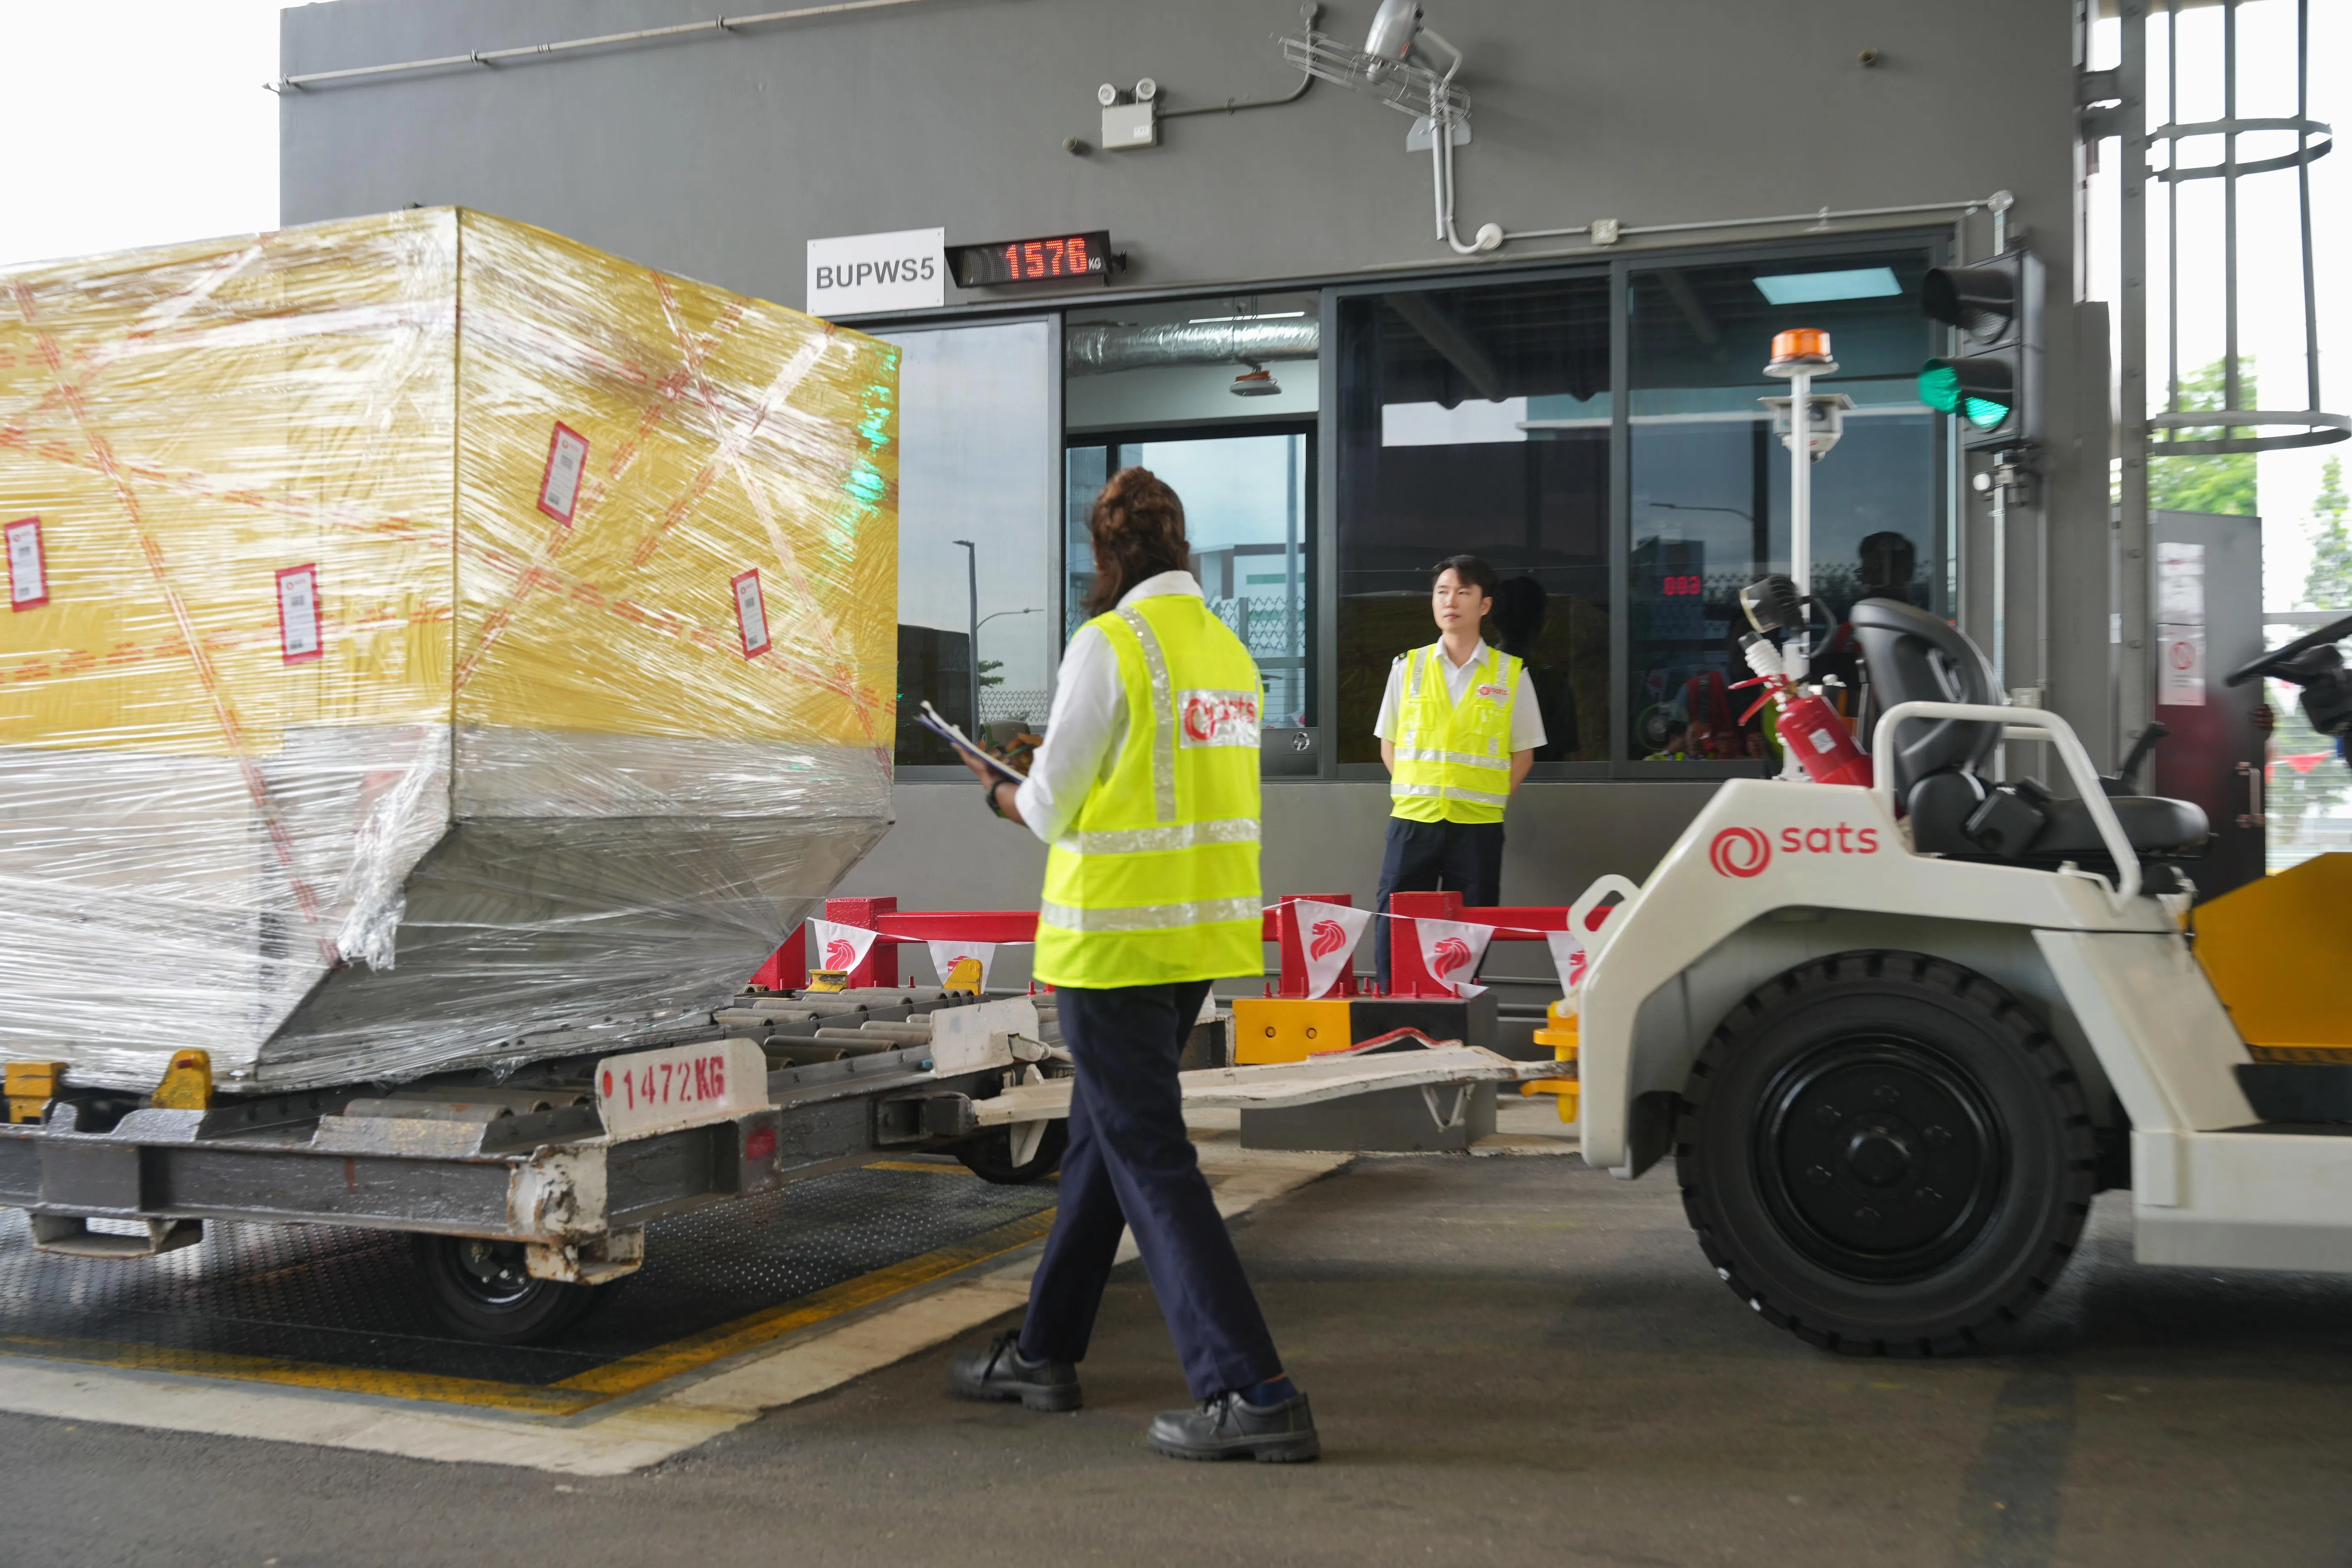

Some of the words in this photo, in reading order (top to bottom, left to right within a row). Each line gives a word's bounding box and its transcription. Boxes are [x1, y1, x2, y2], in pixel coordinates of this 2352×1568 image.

[817, 257, 934, 289] BUPWS5
[1005, 237, 1087, 279] 1576
[1088, 257, 1102, 271] KG
[1782, 822, 1879, 854] sats
